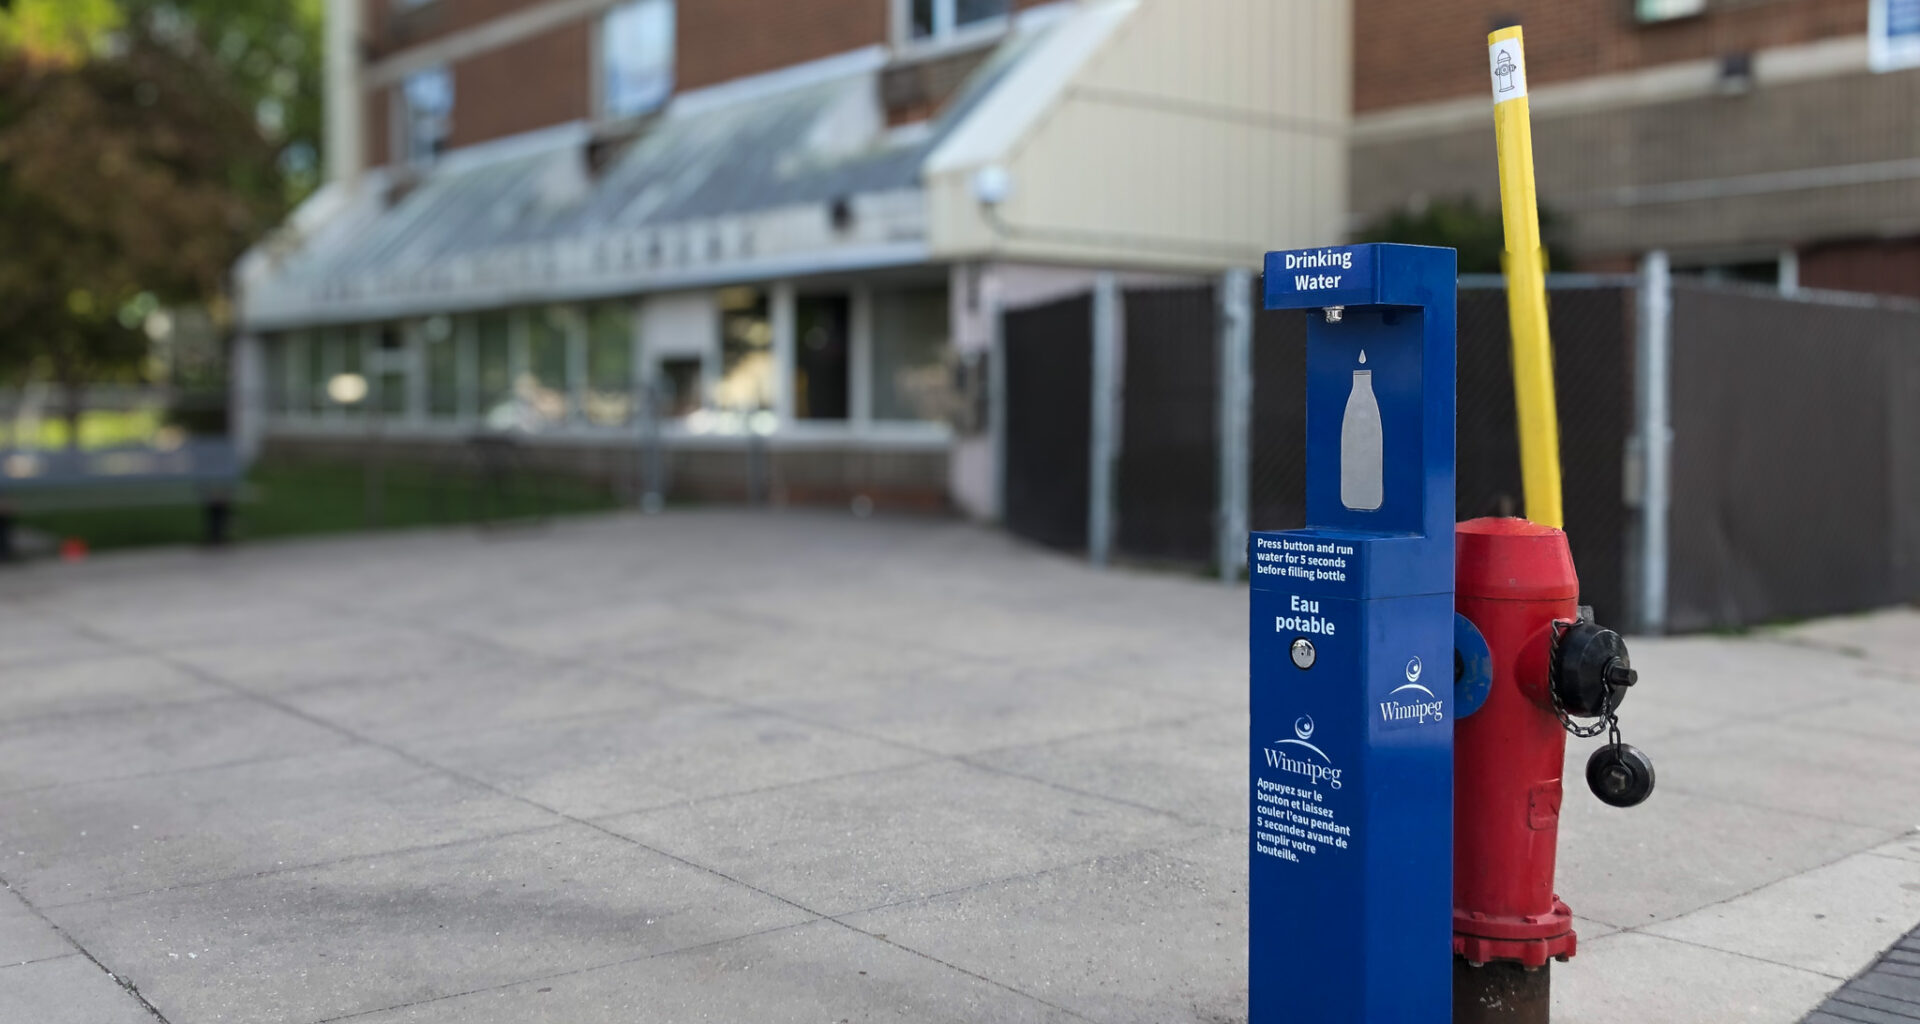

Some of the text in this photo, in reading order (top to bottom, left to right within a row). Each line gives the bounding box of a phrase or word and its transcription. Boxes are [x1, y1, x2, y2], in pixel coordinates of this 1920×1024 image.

[1285, 249, 1352, 269] Drinking
[1295, 275, 1342, 291] Water
[1257, 538, 1353, 555] Press button and run
[1257, 552, 1346, 568] water for 5 seconds
[1257, 563, 1346, 582] before filling bottle
[1291, 595, 1319, 614] Eau
[1276, 615, 1335, 635] potable
[1380, 699, 1443, 723] Winnipeg
[1264, 747, 1342, 790] Winnipeg
[1257, 777, 1323, 802] Appuyez sur le
[1257, 789, 1334, 818] bouton et laissez
[1257, 805, 1350, 837] couler l’eau pendant
[1257, 816, 1348, 849] 5 secondes avant de
[1257, 831, 1316, 854] remplir votre
[1257, 841, 1299, 863] bouteille.
